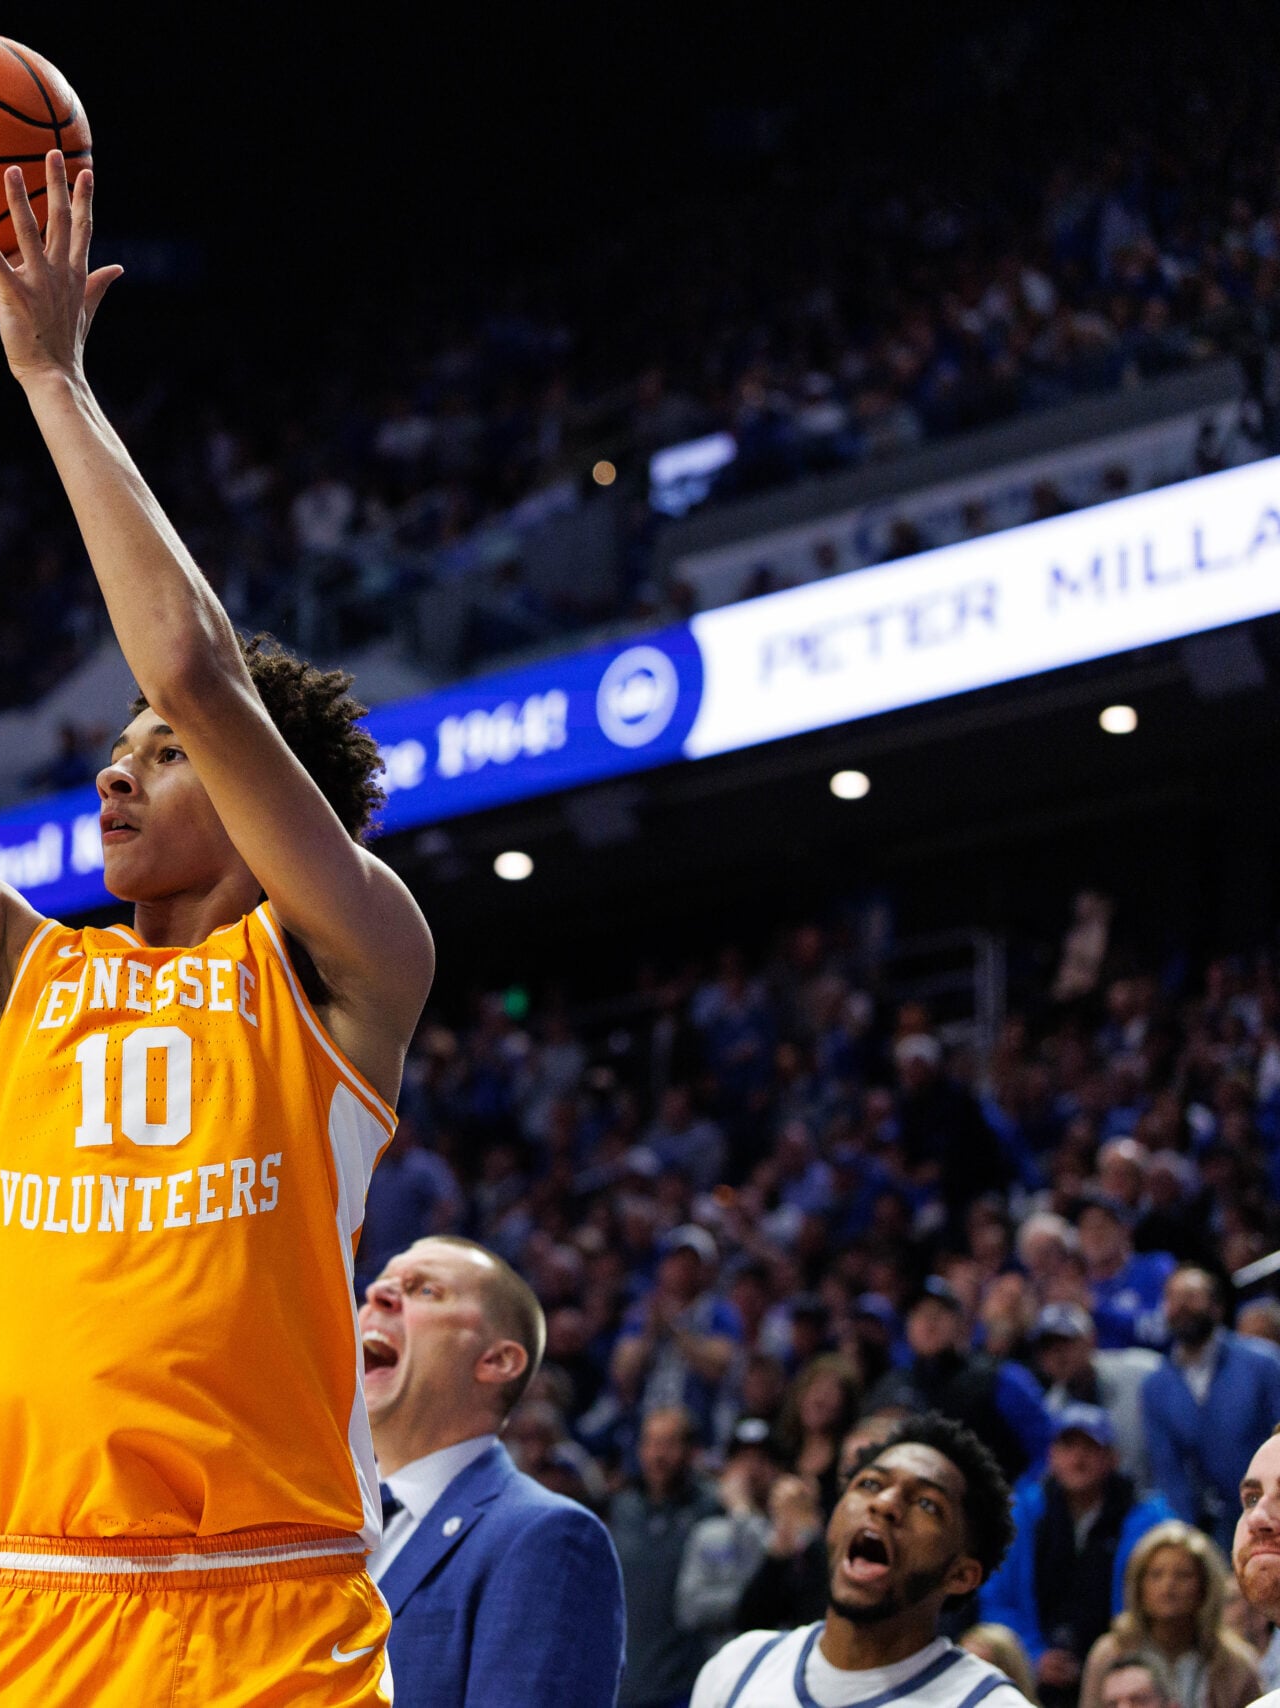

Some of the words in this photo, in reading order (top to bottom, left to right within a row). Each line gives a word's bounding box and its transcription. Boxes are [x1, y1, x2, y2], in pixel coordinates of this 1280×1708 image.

[758, 576, 1004, 688] PETER
[438, 688, 568, 779] 1964!
[75, 1026, 192, 1148] 10
[0, 1152, 283, 1234] VOLUNTEERS
